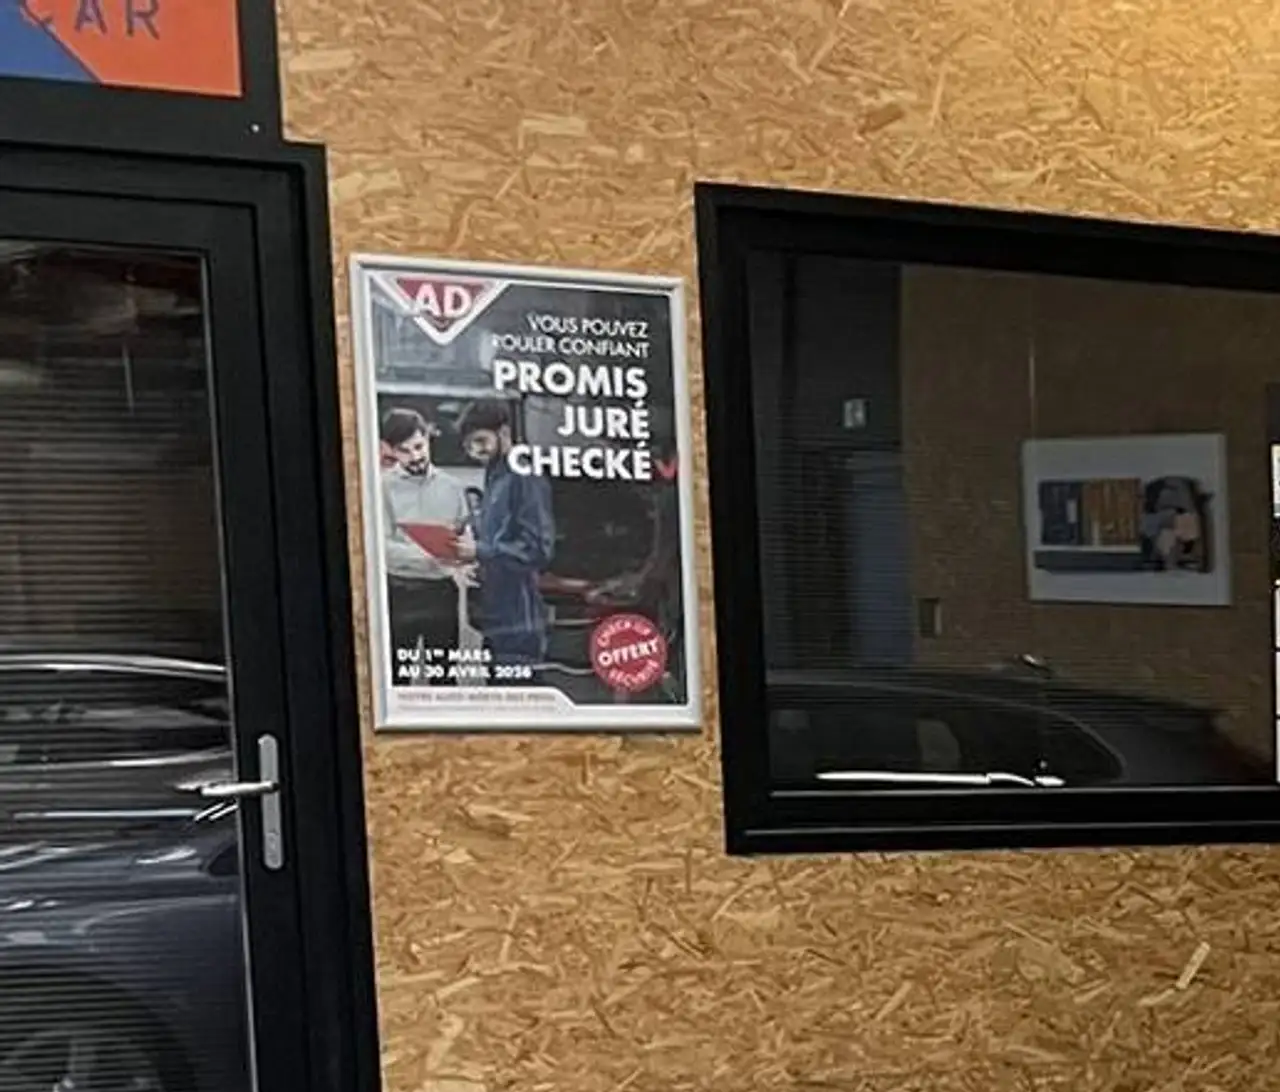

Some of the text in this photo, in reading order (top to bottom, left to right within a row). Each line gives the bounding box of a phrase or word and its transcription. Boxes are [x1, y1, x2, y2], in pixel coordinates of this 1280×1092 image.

[415, 282, 472, 317] AD
[527, 312, 649, 338] VOUS POUVEZ
[559, 337, 650, 358] CONFIANT
[493, 359, 648, 399] PROMIS
[557, 400, 650, 439] JURÉ
[508, 441, 651, 480] CHECKÉ
[397, 648, 419, 661] DU
[448, 648, 492, 662] MARS
[598, 636, 659, 668] OFFERT
[398, 665, 420, 678] AU
[425, 665, 445, 678] 30
